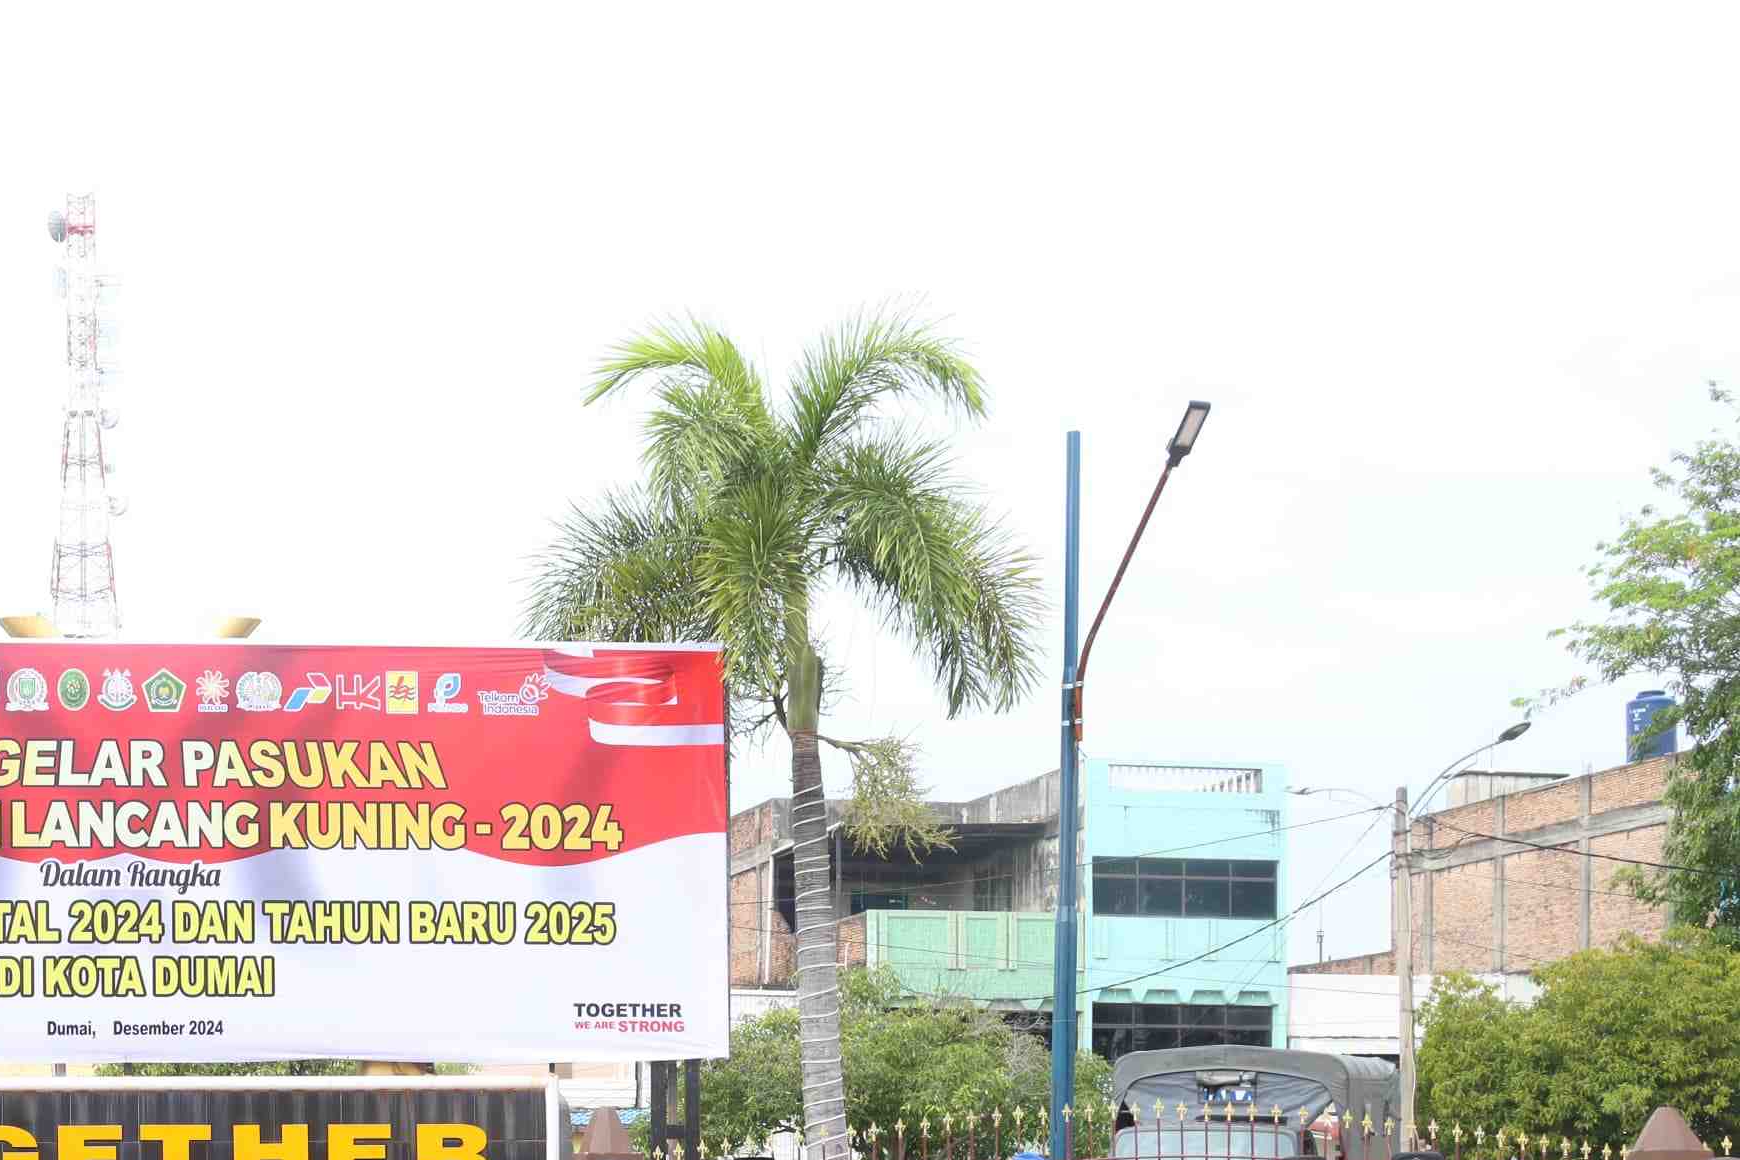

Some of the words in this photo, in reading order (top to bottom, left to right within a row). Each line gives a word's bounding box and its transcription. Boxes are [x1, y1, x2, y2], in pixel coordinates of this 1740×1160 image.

[477, 690, 520, 704] Telkom
[483, 704, 539, 716] Indonesia
[181, 738, 448, 790] PASUKAN
[11, 800, 259, 850] LANCANG
[269, 801, 466, 851] KUNING
[500, 802, 624, 851] 2024
[40, 860, 121, 888] Dalam
[126, 860, 222, 894] Rangka
[68, 901, 164, 944] 2024
[171, 901, 257, 944] DAN
[262, 901, 400, 944] TAHUN
[410, 902, 515, 944] BARU
[525, 902, 617, 945] 2025
[44, 956, 146, 998] KOTA
[153, 956, 275, 998] DUMAI
[573, 1002, 682, 1018] TOGETHER
[47, 1020, 96, 1039] Dumai,
[113, 1020, 185, 1036] Desember
[189, 1020, 224, 1036] 2024
[573, 1020, 591, 1030] WE
[594, 1020, 615, 1030] ARE
[618, 1020, 685, 1033] STRONG
